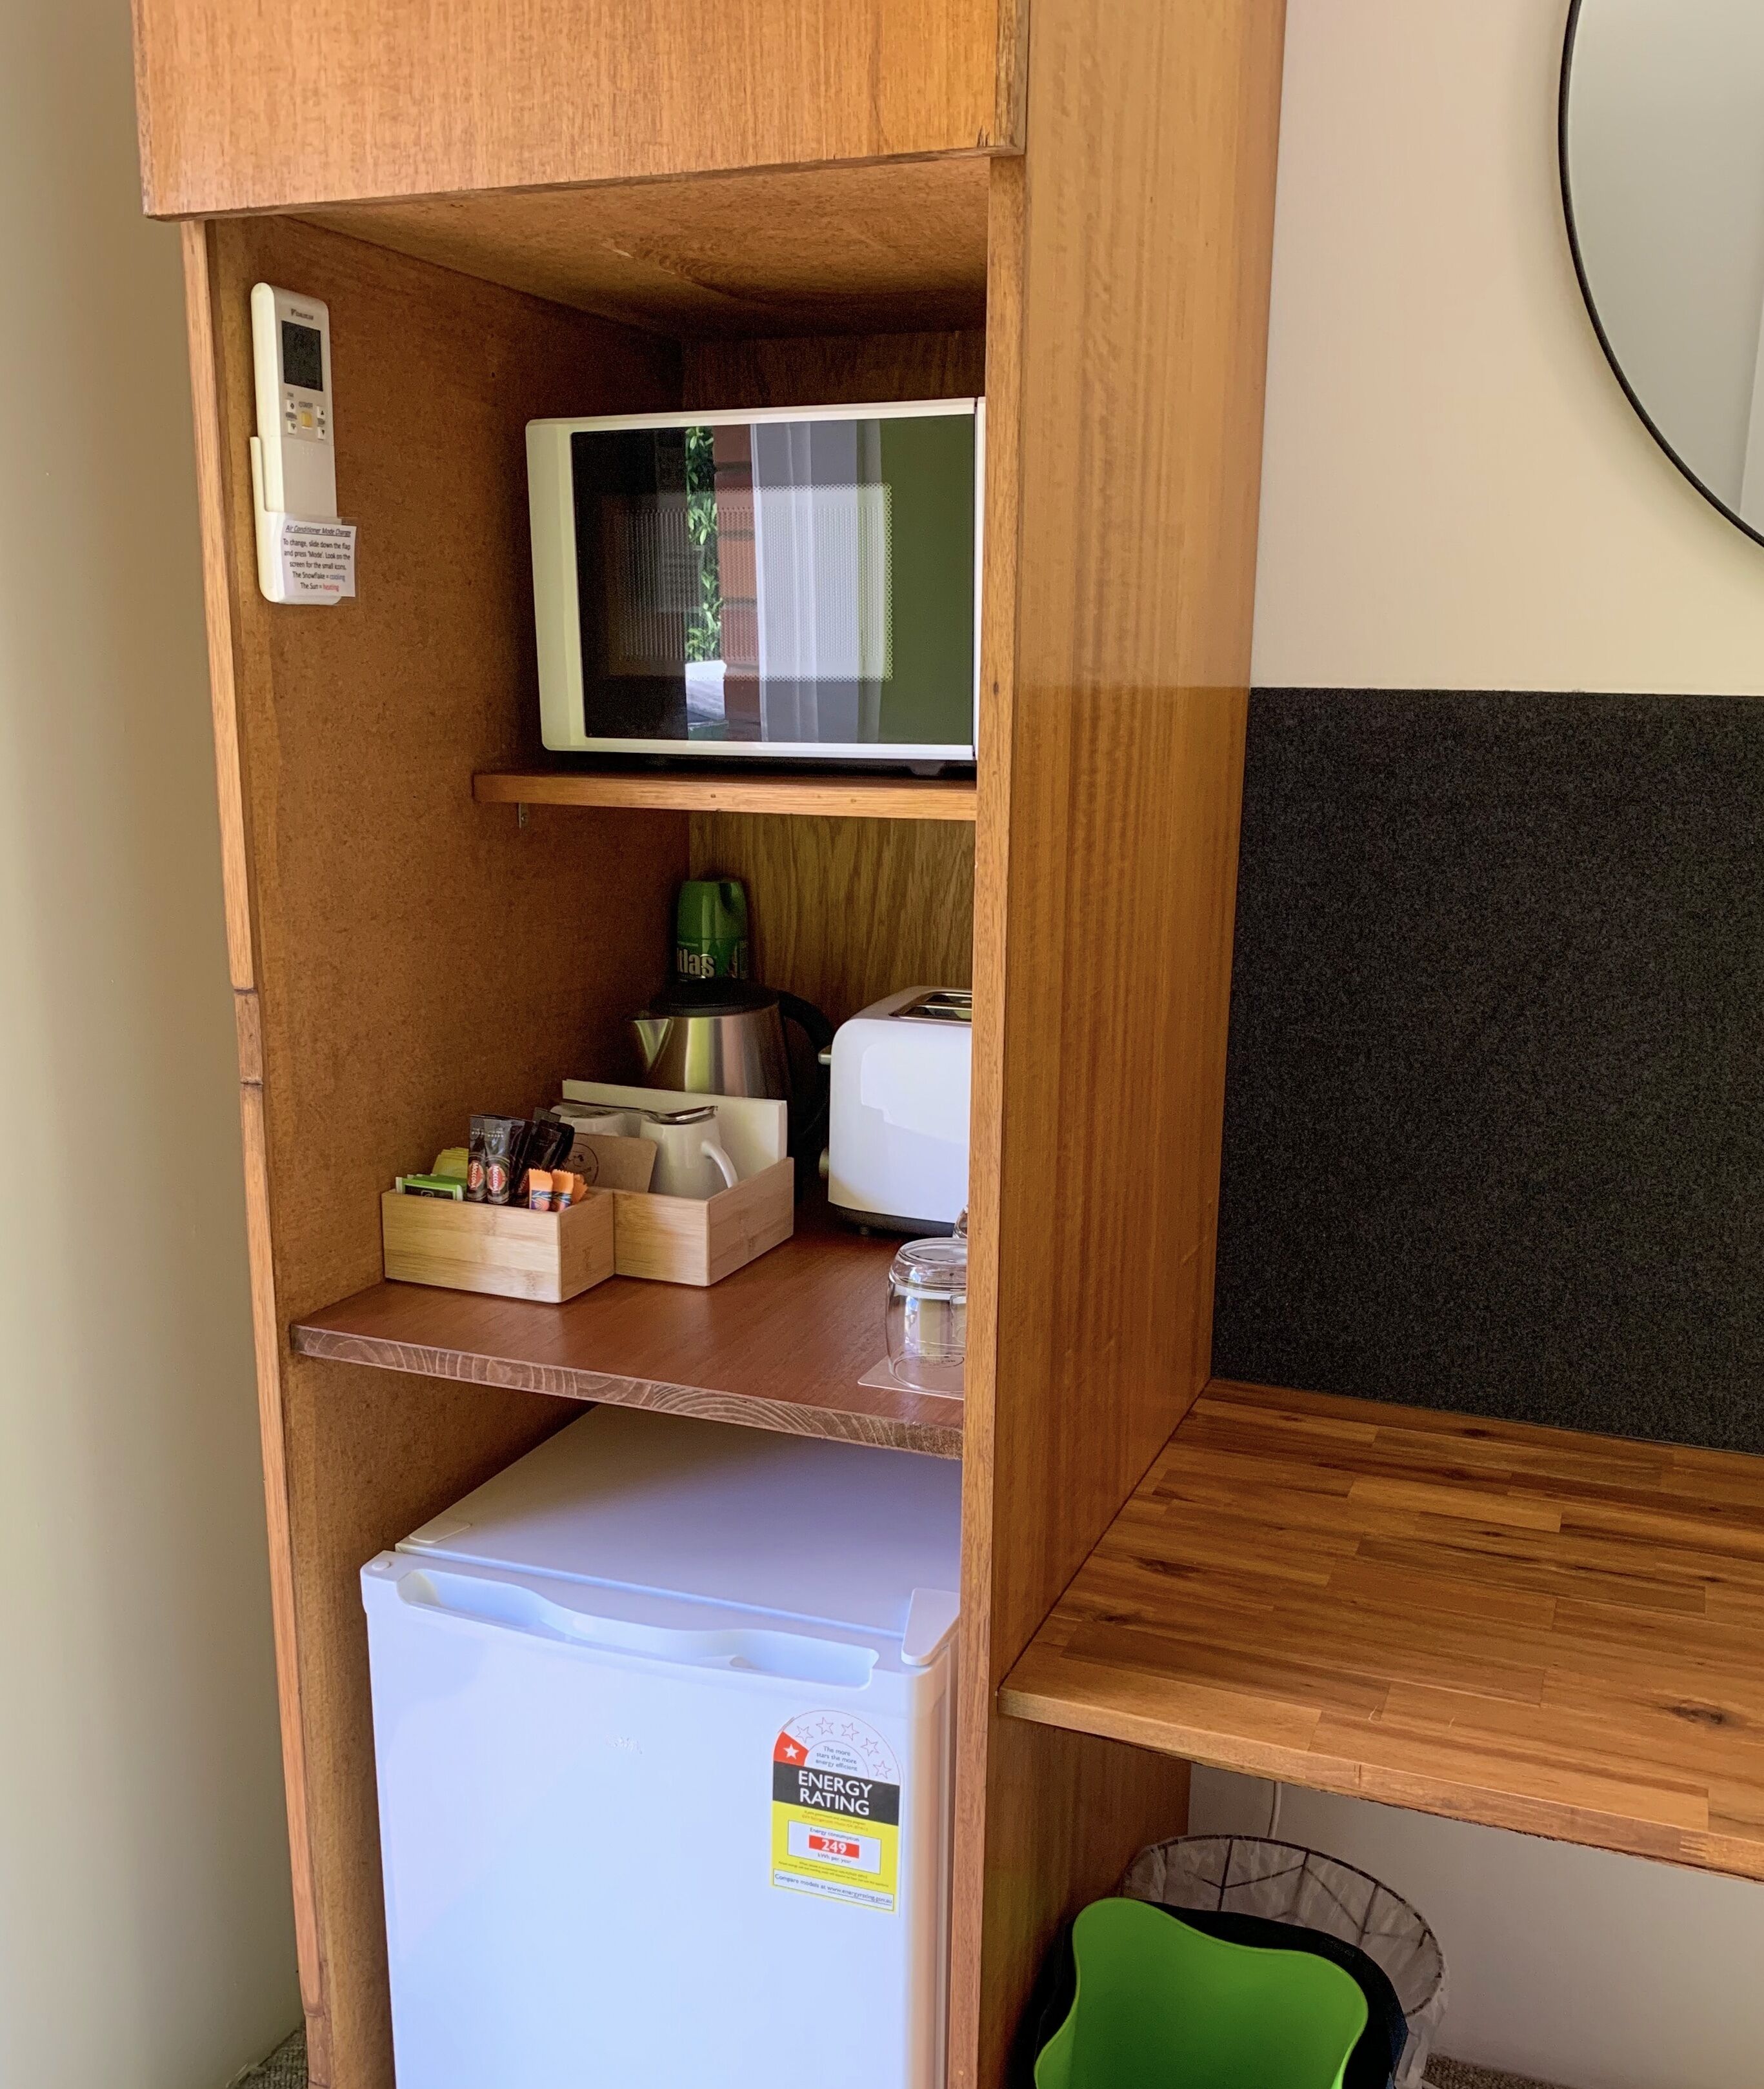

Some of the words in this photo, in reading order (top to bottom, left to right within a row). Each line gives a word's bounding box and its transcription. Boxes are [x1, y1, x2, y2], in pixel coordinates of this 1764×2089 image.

[492, 1165, 501, 1194] MOCCONA
[799, 1770, 872, 1798] ENERGY
[800, 1788, 869, 1815] RATING
[810, 1828, 826, 1836] Energy
[828, 1832, 859, 1842] consumption
[821, 1839, 847, 1854] 249
[775, 1874, 799, 1884] Compare
[801, 1879, 819, 1888] models
